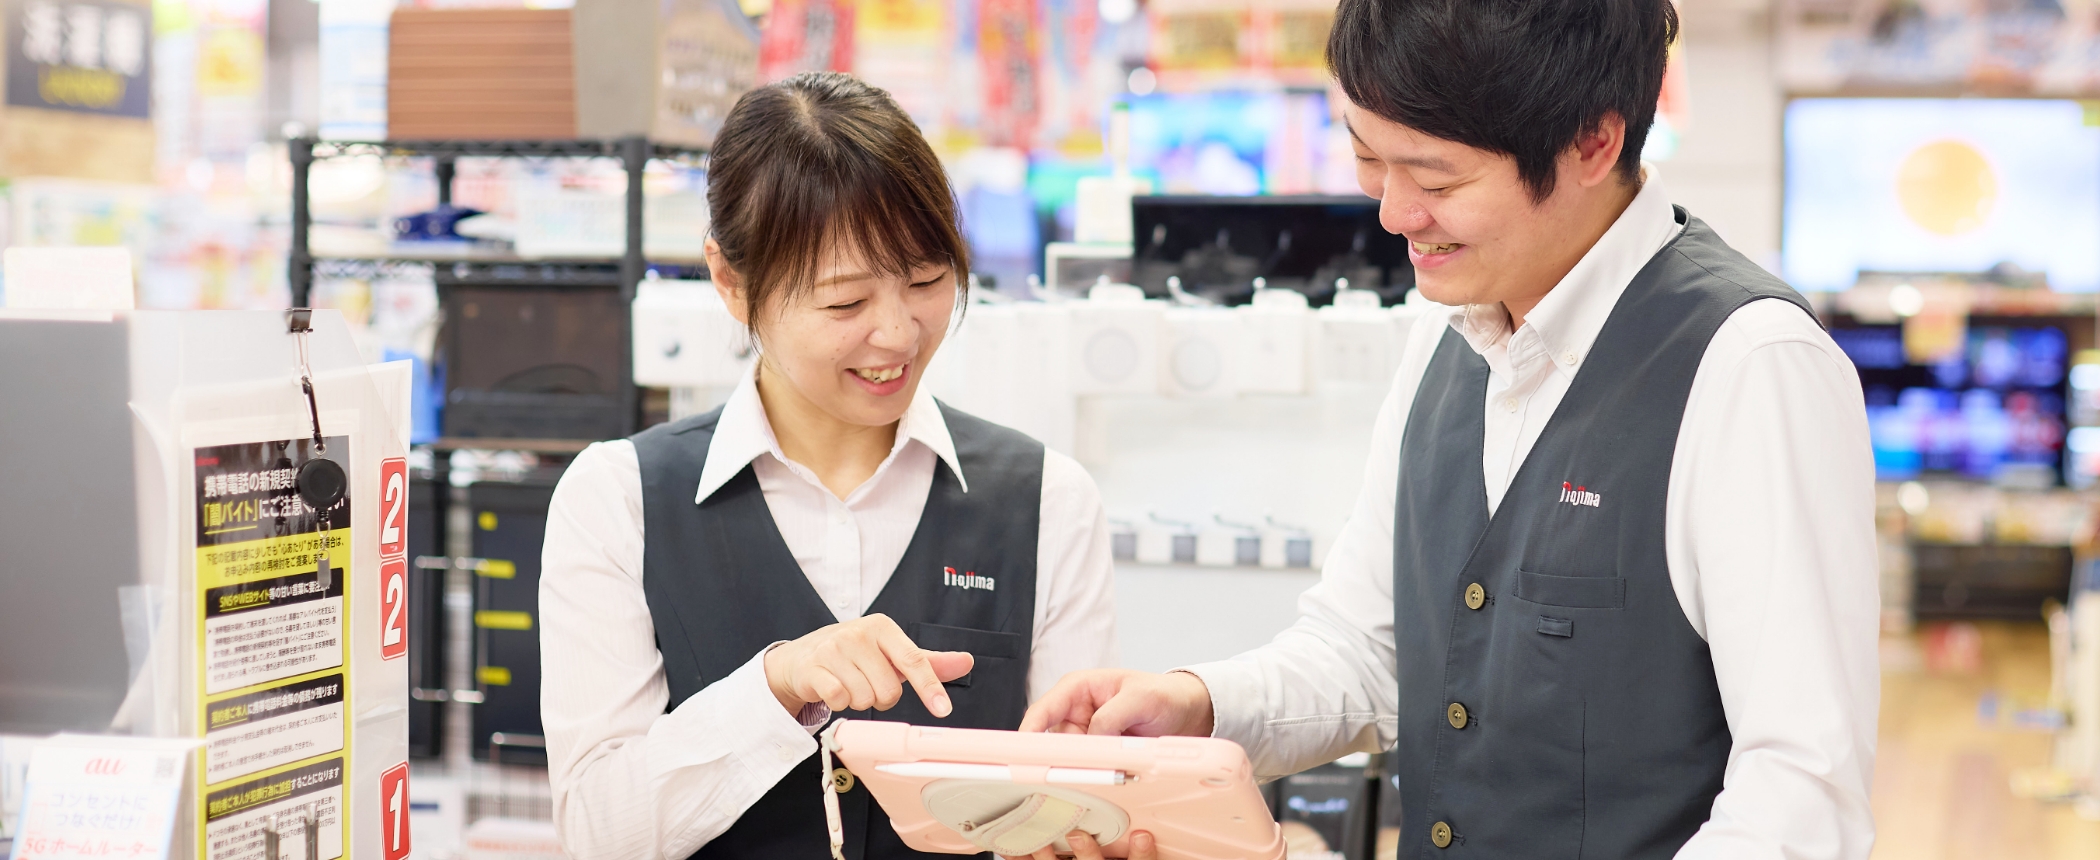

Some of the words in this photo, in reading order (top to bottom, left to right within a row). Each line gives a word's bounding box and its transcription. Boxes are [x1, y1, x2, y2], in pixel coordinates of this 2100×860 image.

[1559, 481, 1601, 507] nojima
[381, 472, 404, 545] 2
[943, 566, 995, 591] nojima
[383, 572, 403, 647] 2
[84, 757, 126, 776] au
[50, 792, 149, 809] コンセントに
[388, 779, 403, 851] 1
